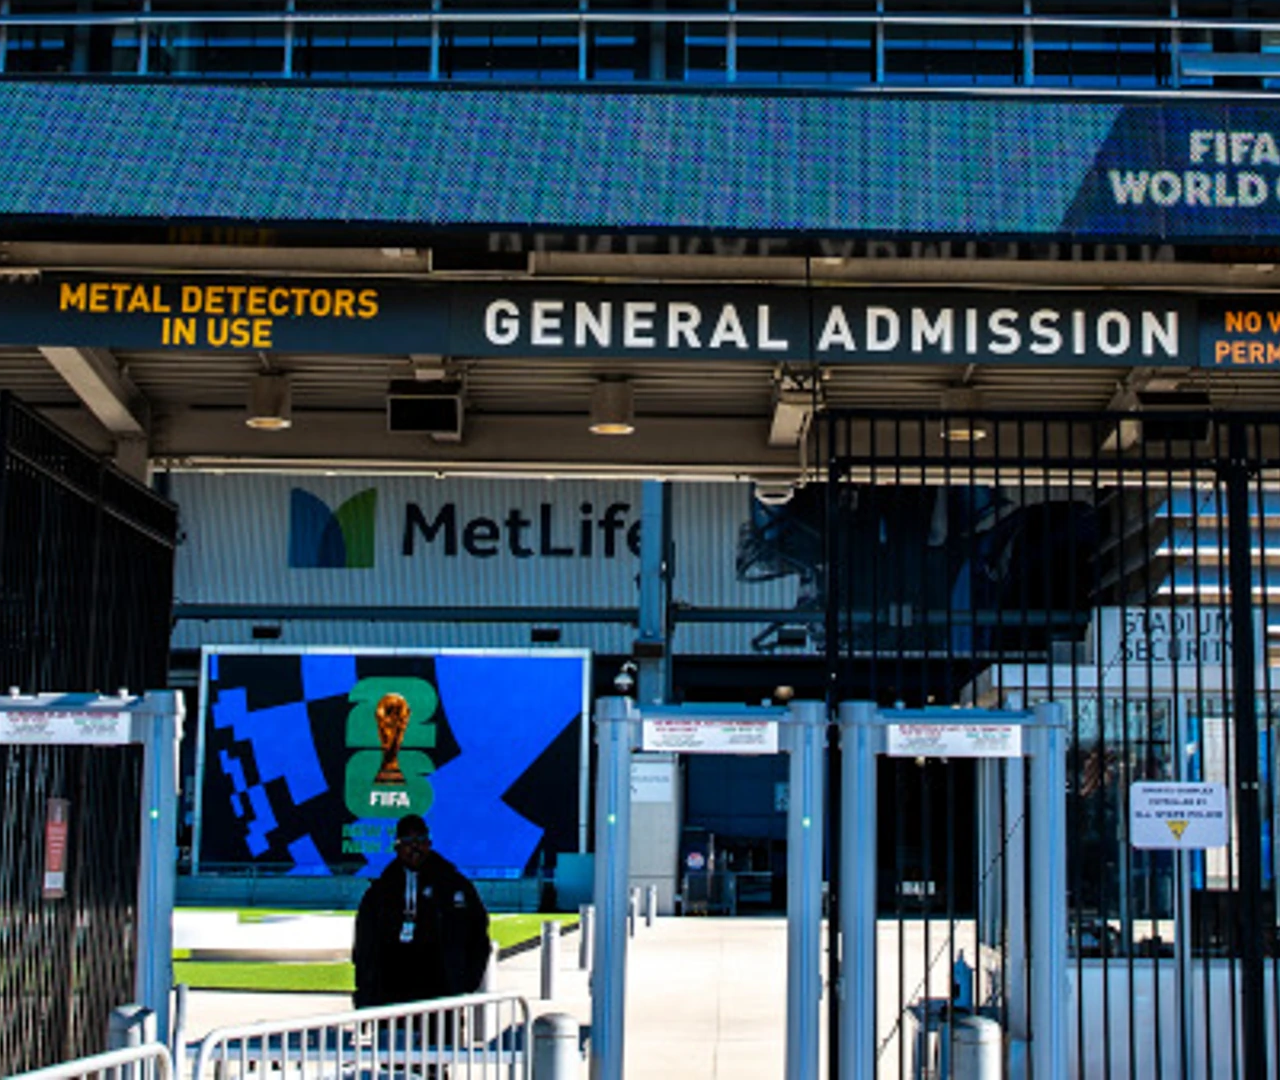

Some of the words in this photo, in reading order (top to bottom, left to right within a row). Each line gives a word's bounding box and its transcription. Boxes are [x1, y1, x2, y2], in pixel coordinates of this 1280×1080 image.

[1189, 129, 1280, 166] FIFA
[1108, 169, 1269, 207] WORLD
[59, 282, 170, 313] METAL
[180, 286, 379, 319] DETECTORS
[161, 317, 196, 346] IN
[206, 319, 273, 348] USE
[484, 299, 790, 351] GENERAL
[817, 304, 1180, 357] ADMISSION
[1224, 311, 1261, 335] NO
[369, 790, 411, 808] FIFA
